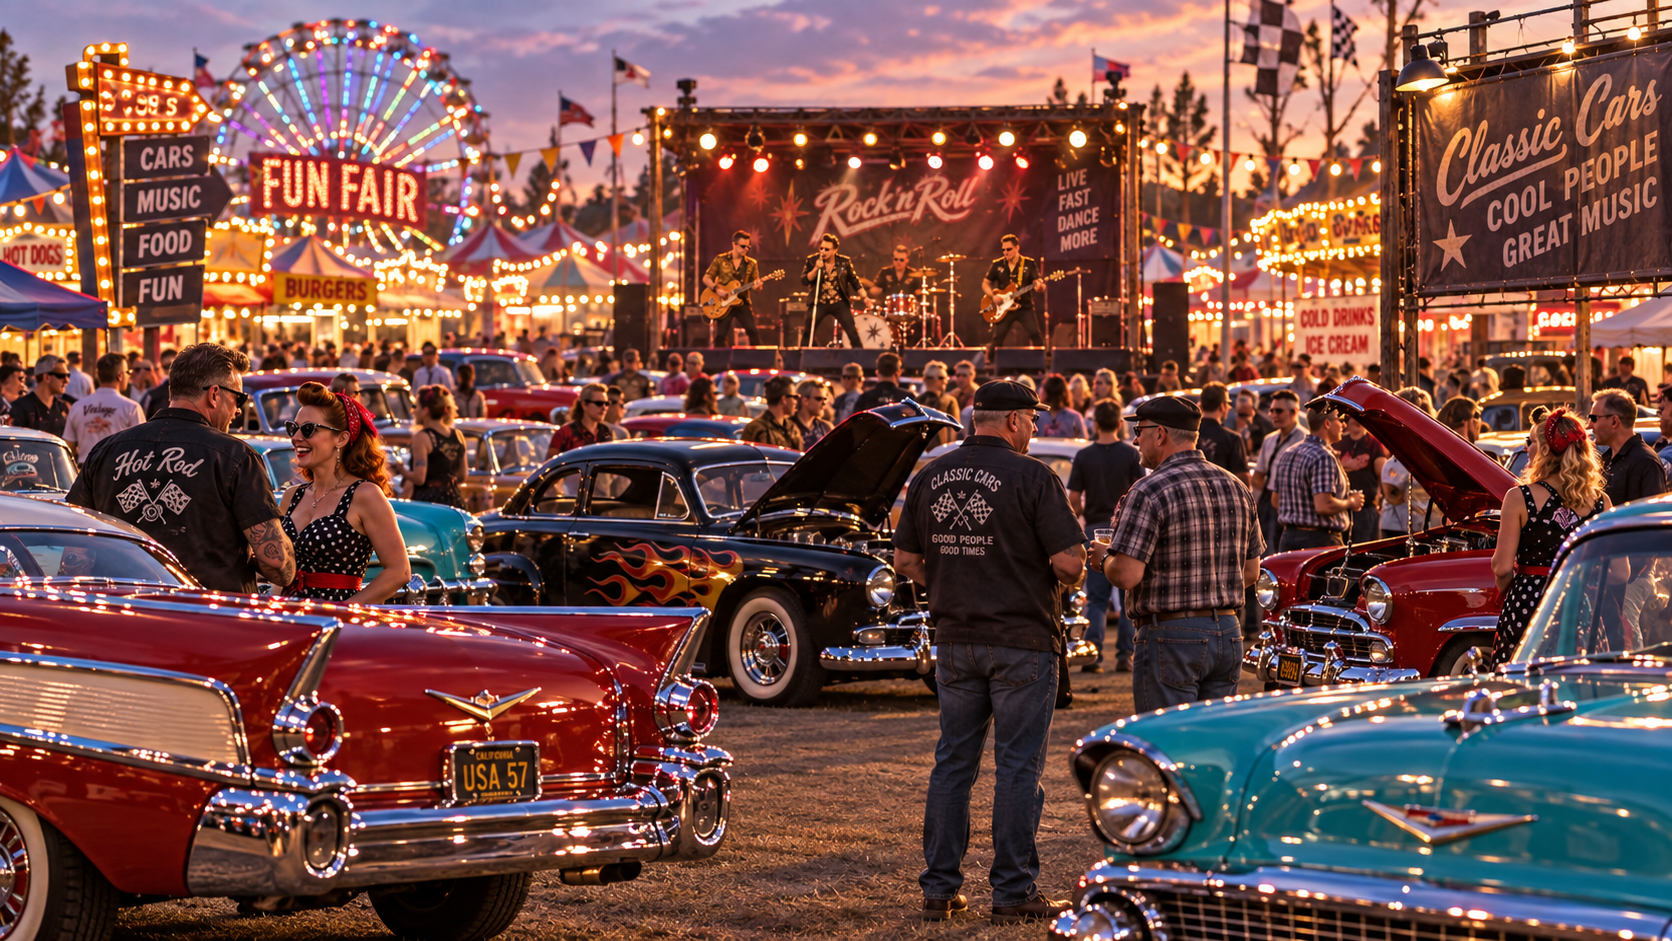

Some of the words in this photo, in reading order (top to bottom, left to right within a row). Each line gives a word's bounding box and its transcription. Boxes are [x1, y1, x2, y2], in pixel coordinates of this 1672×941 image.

[1436, 108, 1563, 206] Classic
[1575, 73, 1662, 147] Cars
[140, 144, 194, 171] CARS
[262, 157, 330, 209] FUN
[340, 163, 419, 222] FAIR
[1058, 168, 1087, 191] LIVE
[1487, 179, 1552, 232] COOL
[1564, 130, 1658, 201] PEOPLE
[136, 184, 202, 214] MUSIC
[1059, 188, 1091, 212] FAST
[1058, 206, 1099, 233] DANCE
[1502, 212, 1572, 268] GREAT
[1581, 176, 1657, 236] MUSIC
[138, 229, 193, 258] FOOD
[1060, 227, 1098, 253] MORE
[3, 245, 27, 265] HOT
[31, 244, 62, 265] DOGS
[138, 275, 183, 303] FUN
[285, 277, 367, 300] BURGERS
[1301, 309, 1329, 329] COLD
[1333, 307, 1375, 327] DRINKS
[1306, 335, 1324, 354] ICE
[1328, 335, 1368, 354] CREAM
[113, 449, 155, 481] Hot
[157, 447, 204, 477] Rod
[931, 468, 973, 490] CLASSIC
[974, 469, 1001, 492] CARS
[932, 534, 956, 544] GOOD
[960, 535, 993, 545] PEOPLE
[940, 545, 959, 555] GOOD
[962, 546, 985, 556] TIMES
[463, 763, 500, 791] USA
[507, 761, 528, 789] 57
